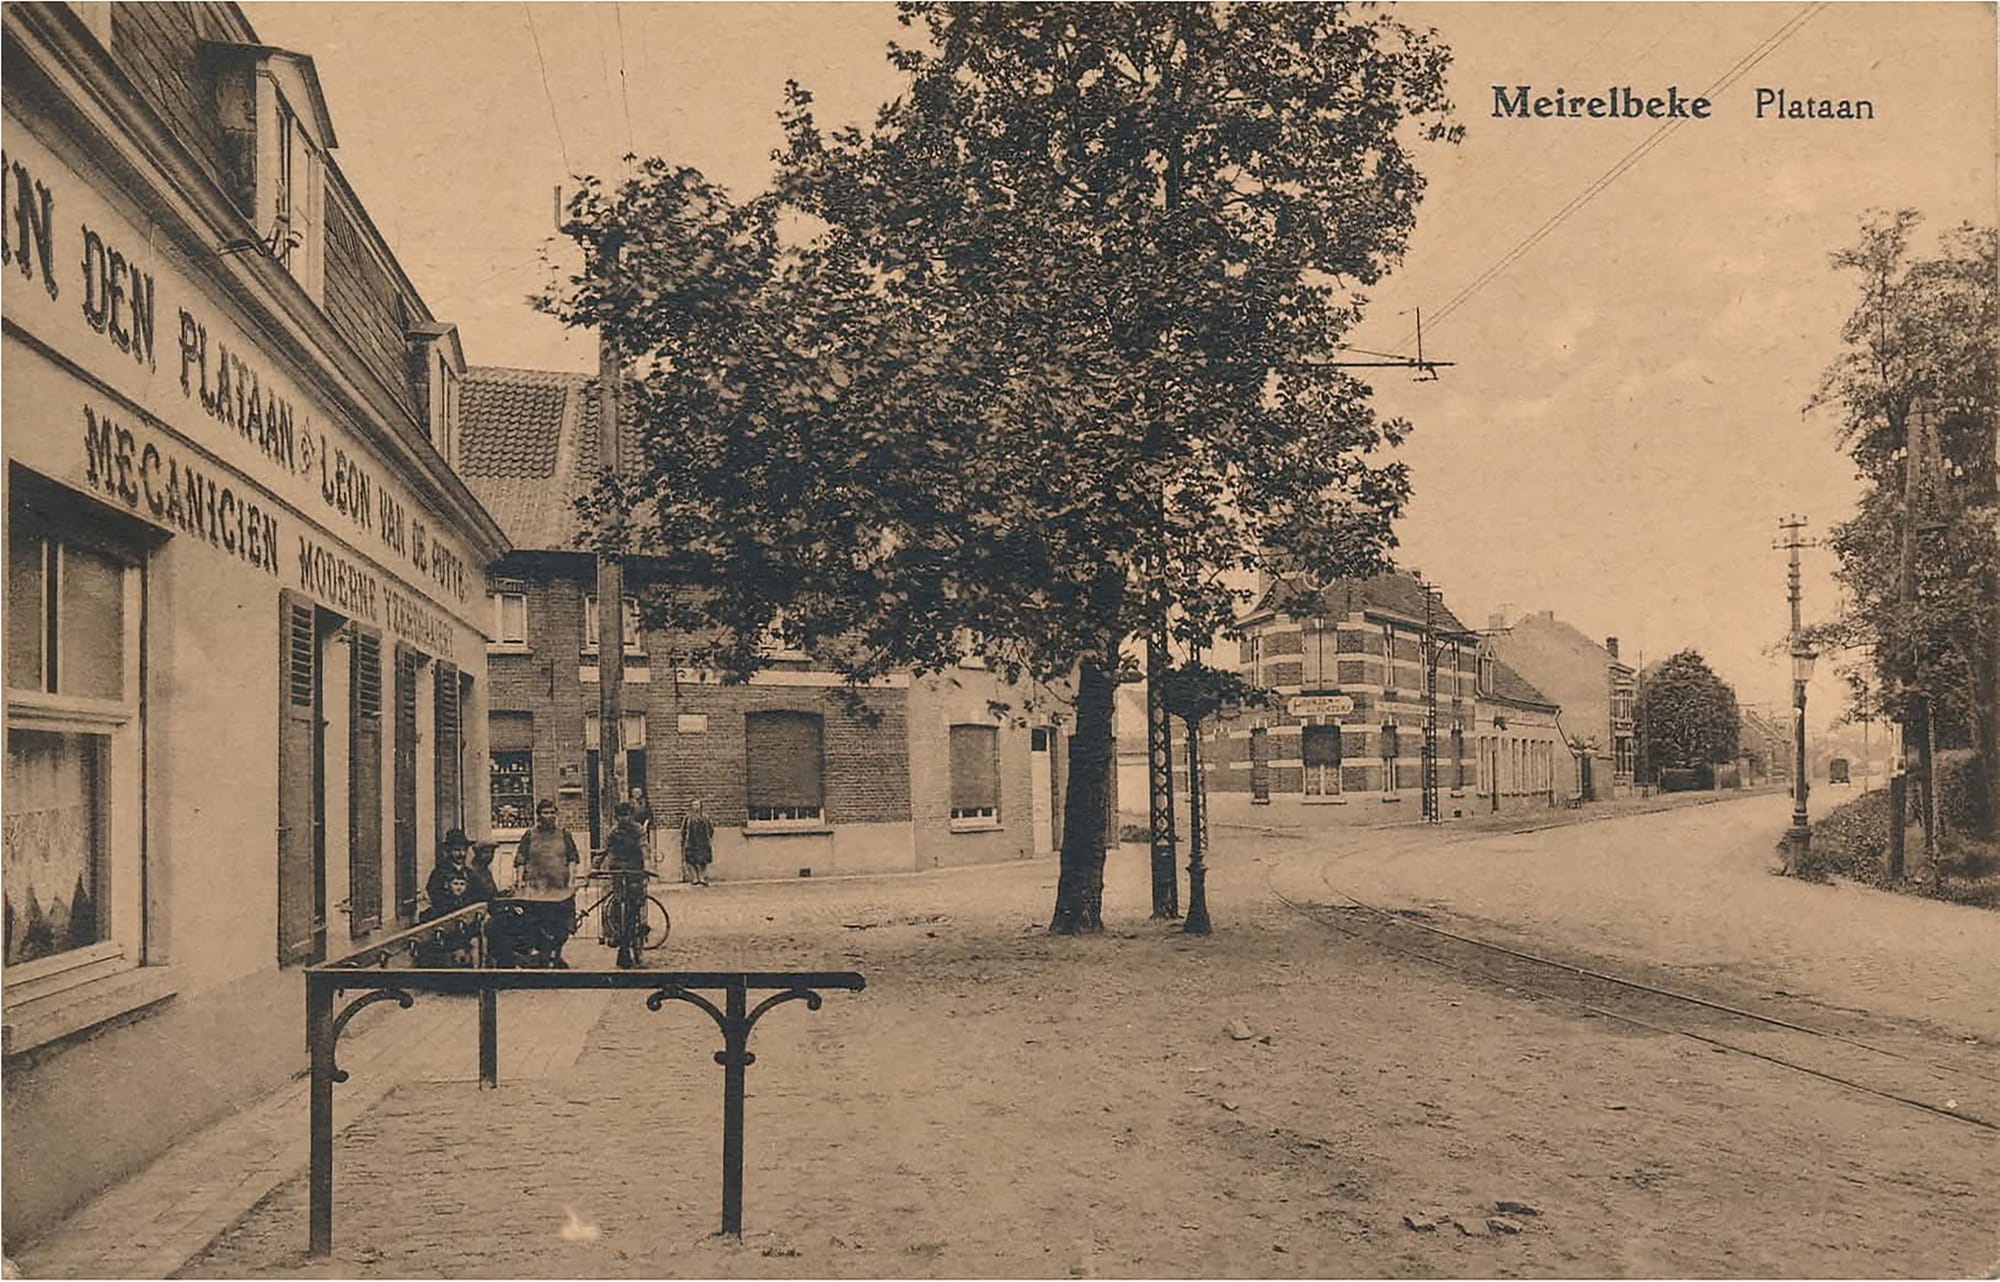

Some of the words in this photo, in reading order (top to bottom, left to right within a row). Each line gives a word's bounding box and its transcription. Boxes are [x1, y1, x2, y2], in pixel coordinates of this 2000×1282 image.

[82, 224, 156, 374] DEN
[178, 306, 296, 476] PLATAAN
[320, 433, 372, 530] LEON
[378, 485, 406, 558] VAN
[84, 403, 279, 577] MECANICIEN
[298, 535, 377, 622] MODERNE
